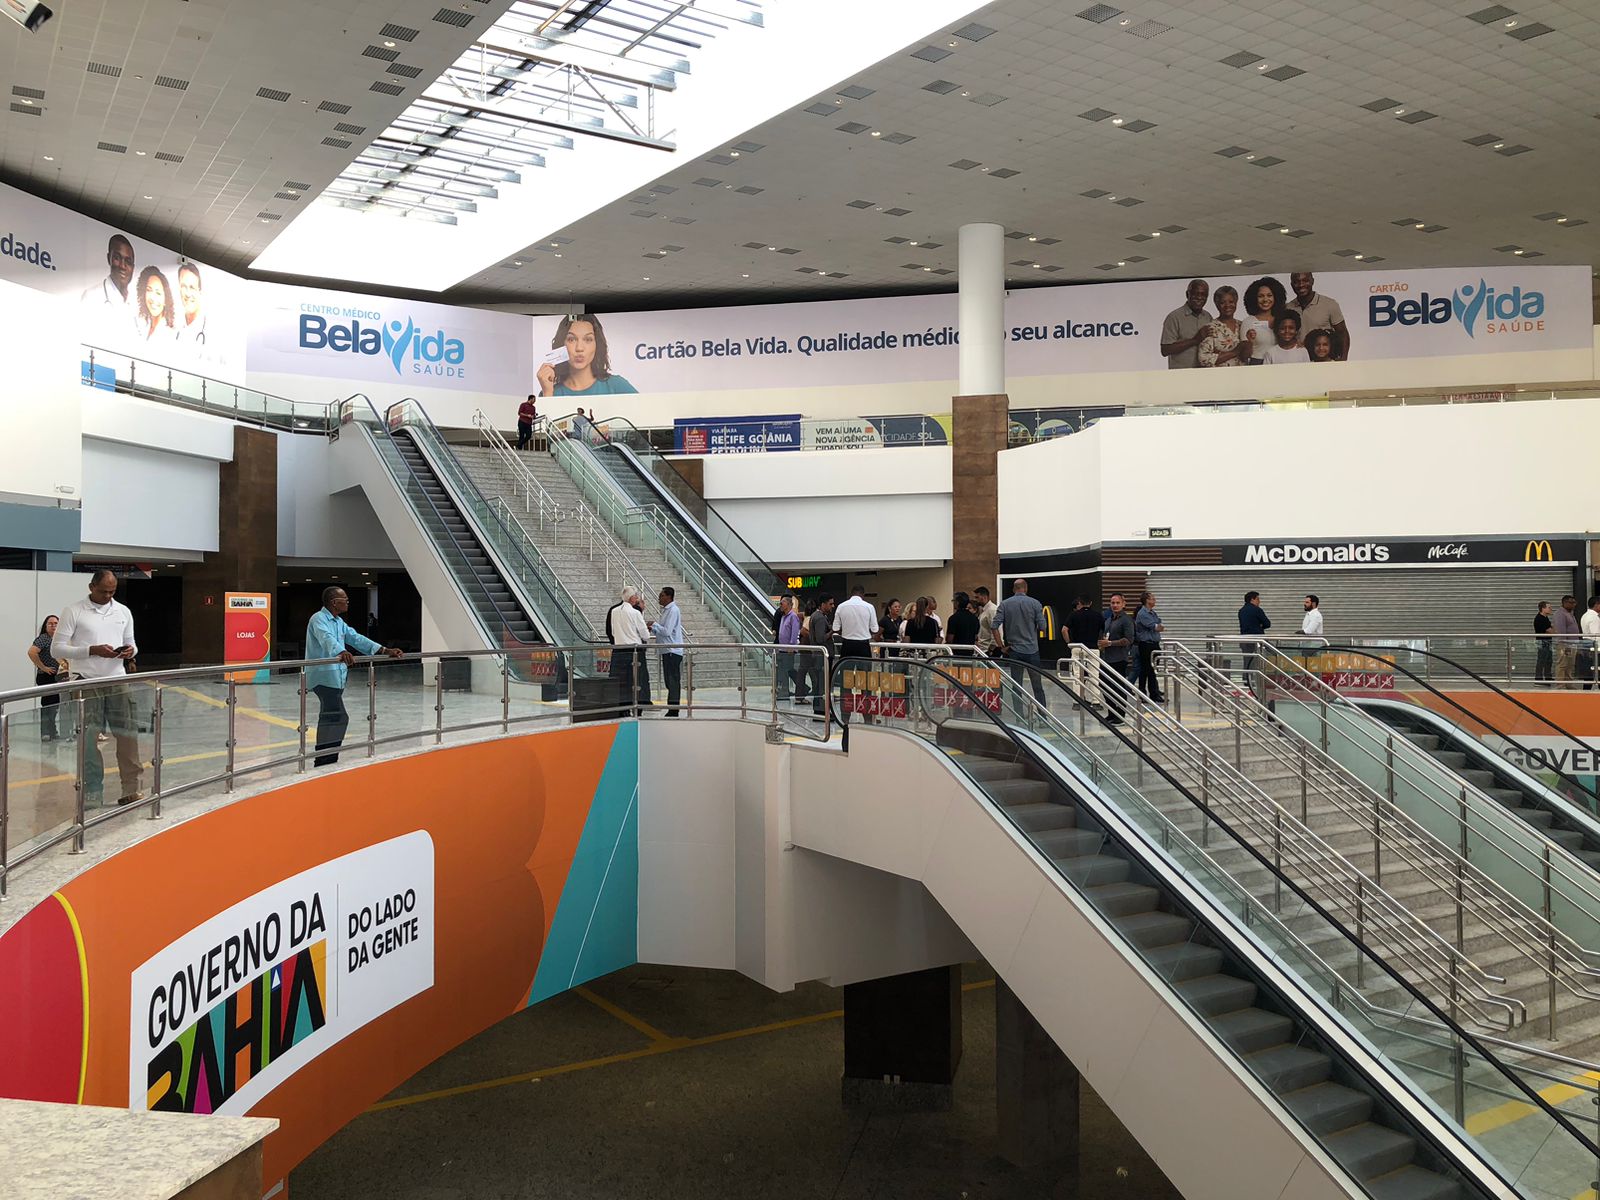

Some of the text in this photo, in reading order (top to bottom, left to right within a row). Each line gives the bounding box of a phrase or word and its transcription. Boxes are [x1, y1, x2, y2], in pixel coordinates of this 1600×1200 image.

[0, 233, 56, 271] dade.
[1369, 282, 1409, 293] CARTÃO
[300, 303, 381, 320] CENTRO MÉDICO
[1487, 319, 1545, 333] SAÚDE
[635, 341, 697, 360] Cartão
[702, 338, 741, 357] Bela
[746, 336, 793, 355] Vida.
[797, 331, 898, 356] Qualidade
[902, 327, 959, 347] médic
[1011, 326, 1048, 341] seu
[1053, 319, 1139, 339] alcance.
[413, 363, 465, 378] SAÚDE
[711, 434, 745, 445] RECIFE
[749, 432, 793, 444] GOIÂNIA
[1245, 544, 1390, 563] McDonald's
[1428, 543, 1469, 559] McCafé
[787, 576, 820, 588] SUBWAY
[236, 631, 255, 639] LOJAS
[349, 888, 416, 940] DO LADO
[349, 917, 418, 973] DA GENTE
[149, 892, 326, 1048] GOVERNO DA
